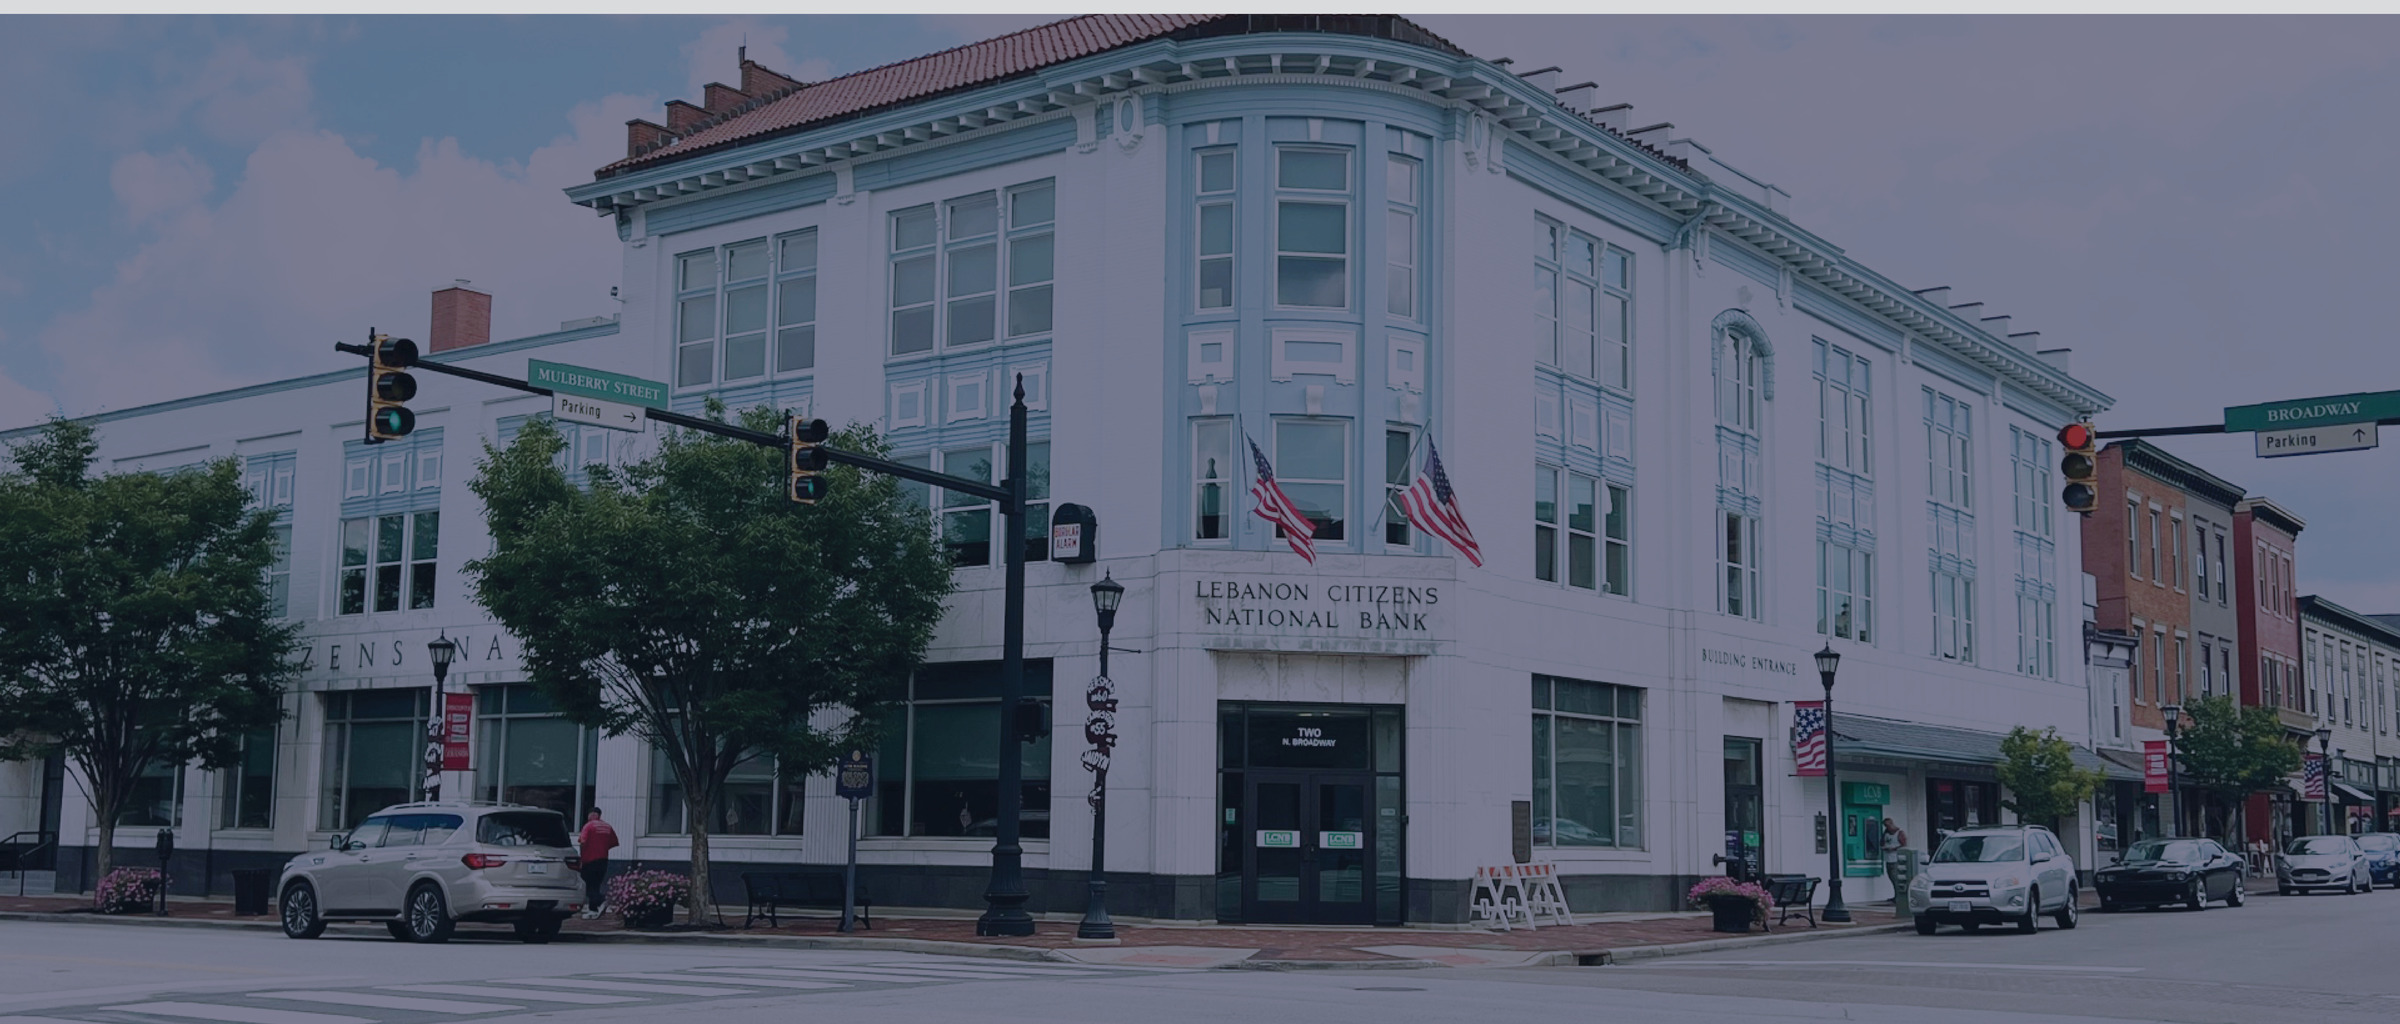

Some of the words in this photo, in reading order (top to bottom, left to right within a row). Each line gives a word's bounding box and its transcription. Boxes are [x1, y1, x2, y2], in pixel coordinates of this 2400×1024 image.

[538, 367, 610, 392] MULBERRY
[614, 381, 661, 401] STREET
[562, 399, 601, 419] Parking
[2267, 402, 2361, 422] BROADWAY
[2266, 434, 2316, 448] Parking
[1056, 537, 1077, 549] ALARM
[1196, 580, 1309, 601] LEBANON
[1327, 585, 1439, 605] CITIZENS
[1206, 607, 1339, 629] NATIONAL
[1360, 611, 1428, 631] BANK
[301, 640, 404, 671] ZENS
[452, 634, 503, 663] NA
[1702, 648, 1746, 668] BUILDING
[1752, 656, 1797, 676] ENTRANCE
[1282, 738, 1291, 746] N.
[1292, 738, 1337, 747] BROADWAY
[1297, 727, 1322, 738] TWO
[1265, 832, 1291, 843] LCNB
[1328, 834, 1355, 845] LCNB
